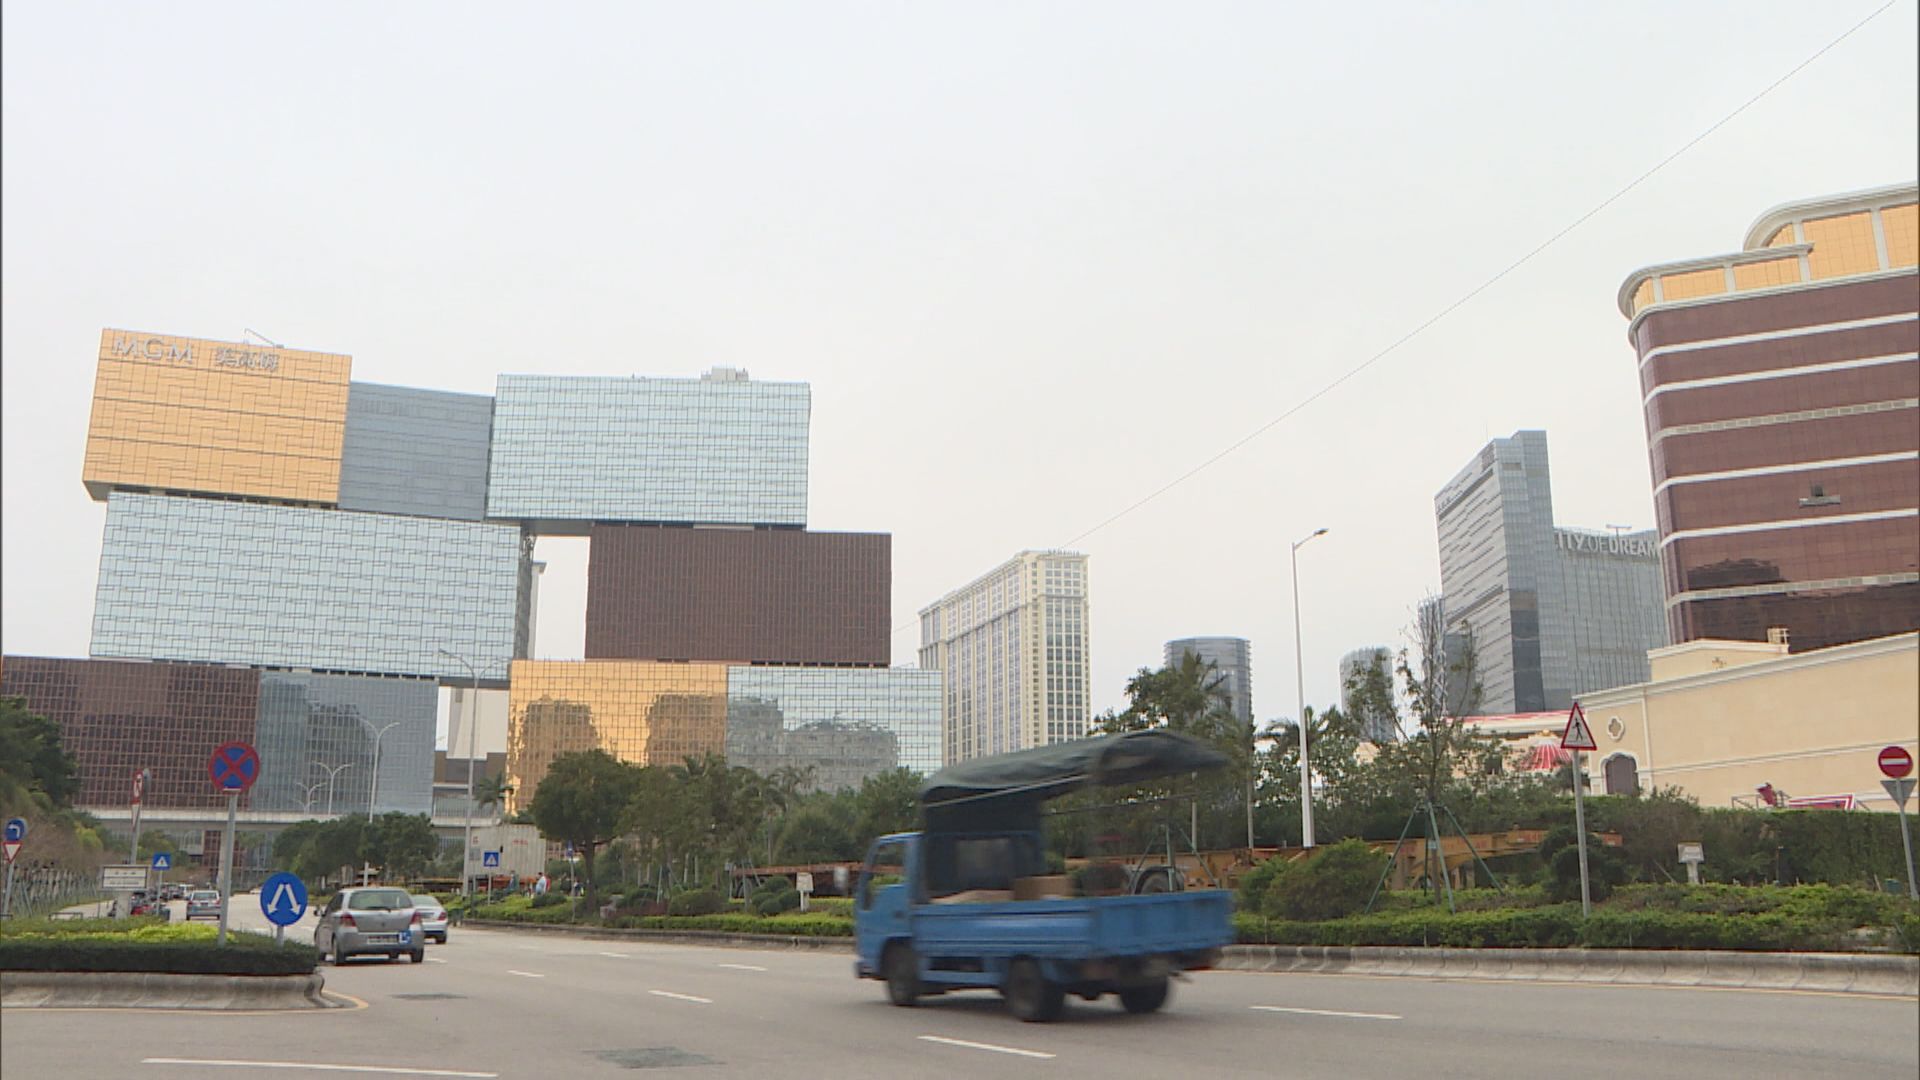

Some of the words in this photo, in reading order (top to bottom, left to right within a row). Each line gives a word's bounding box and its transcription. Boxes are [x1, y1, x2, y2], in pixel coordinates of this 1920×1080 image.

[113, 337, 192, 363] MGM
[1553, 530, 1585, 550] ITY
[1588, 535, 1608, 553] OF
